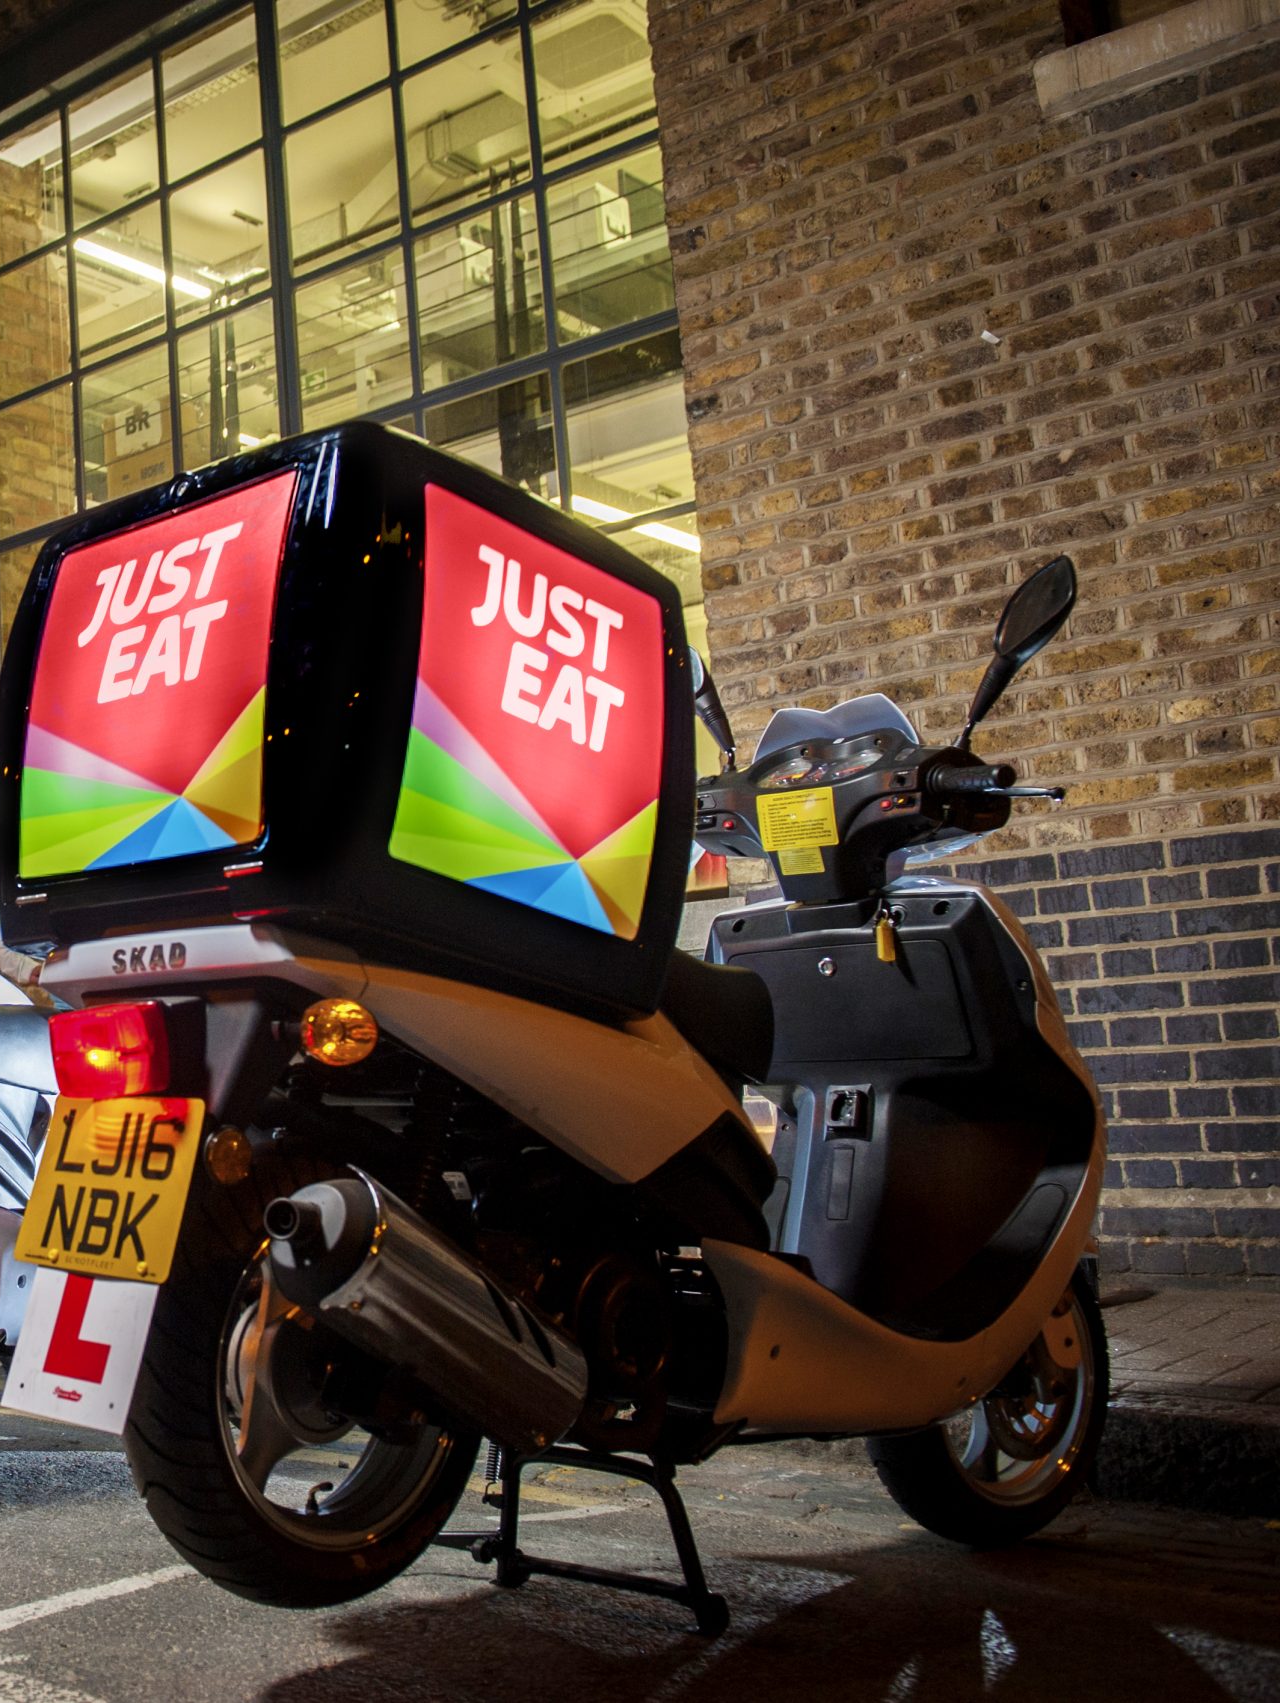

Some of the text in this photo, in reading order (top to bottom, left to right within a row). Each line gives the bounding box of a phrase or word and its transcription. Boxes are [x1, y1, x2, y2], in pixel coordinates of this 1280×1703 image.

[77, 522, 243, 648] JUST
[471, 543, 623, 673] JUST
[97, 599, 228, 704] EAT
[500, 641, 625, 753] EAT
[112, 942, 187, 975] SKAD
[55, 1109, 185, 1181] LJ16
[40, 1184, 160, 1262] NBK
[43, 1273, 111, 1384] L
